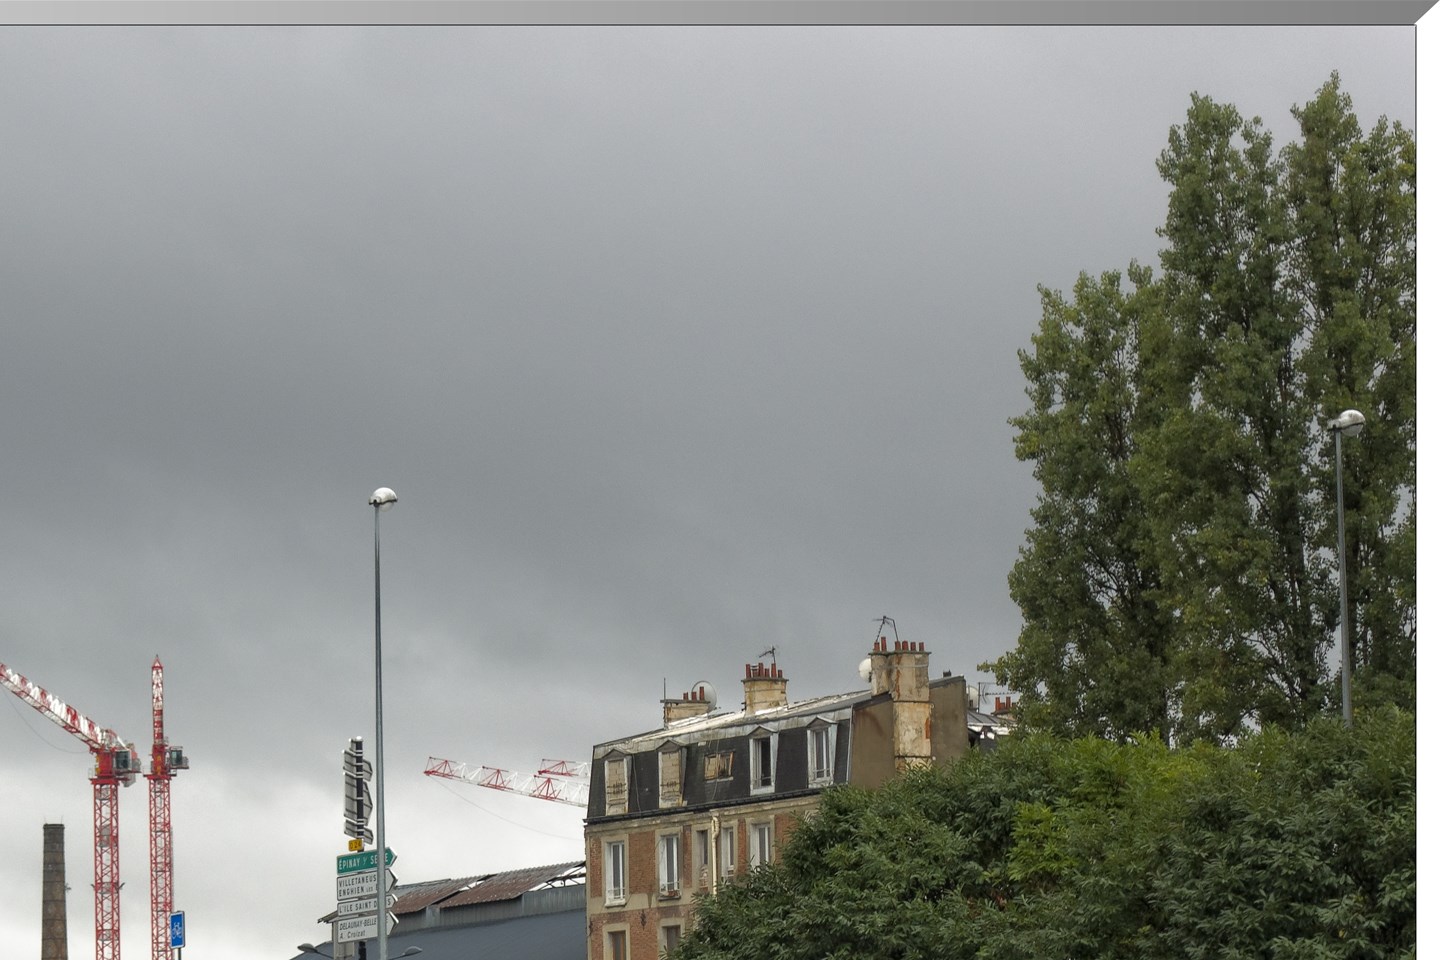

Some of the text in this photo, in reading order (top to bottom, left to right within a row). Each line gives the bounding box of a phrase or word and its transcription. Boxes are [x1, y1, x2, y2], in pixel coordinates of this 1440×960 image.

[370, 852, 389, 865] SEE
[339, 874, 377, 887] VILLETANEUS
[355, 900, 371, 911] SAINT
